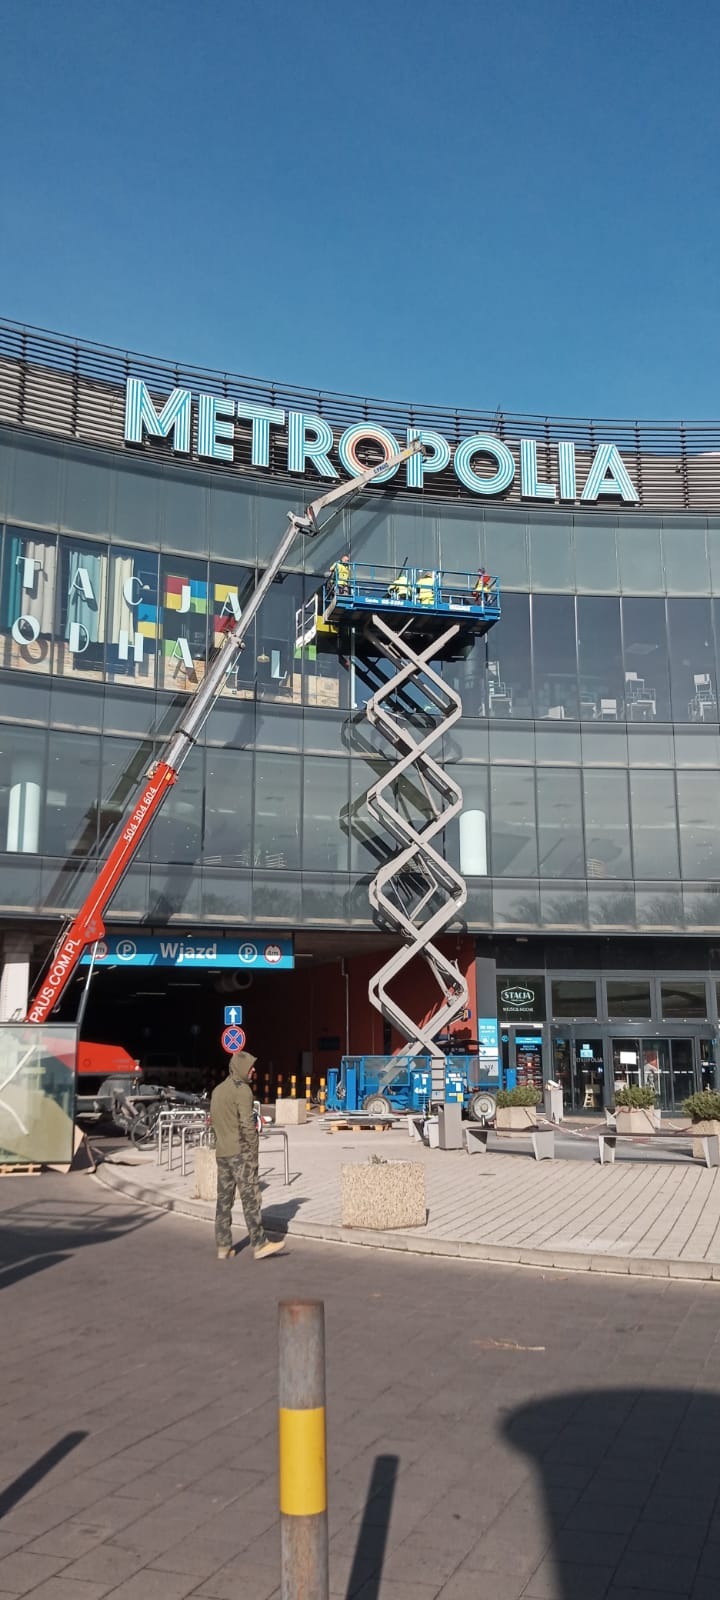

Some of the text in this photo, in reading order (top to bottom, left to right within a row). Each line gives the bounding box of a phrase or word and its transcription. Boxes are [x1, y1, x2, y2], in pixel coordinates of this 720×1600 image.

[124, 377, 640, 503] METROPOLIA
[123, 786, 157, 843] 504 304 604
[25, 938, 82, 1023] PAUS.COM.PL
[160, 942, 217, 963] Wjazd
[504, 991, 531, 1000] STACJA
